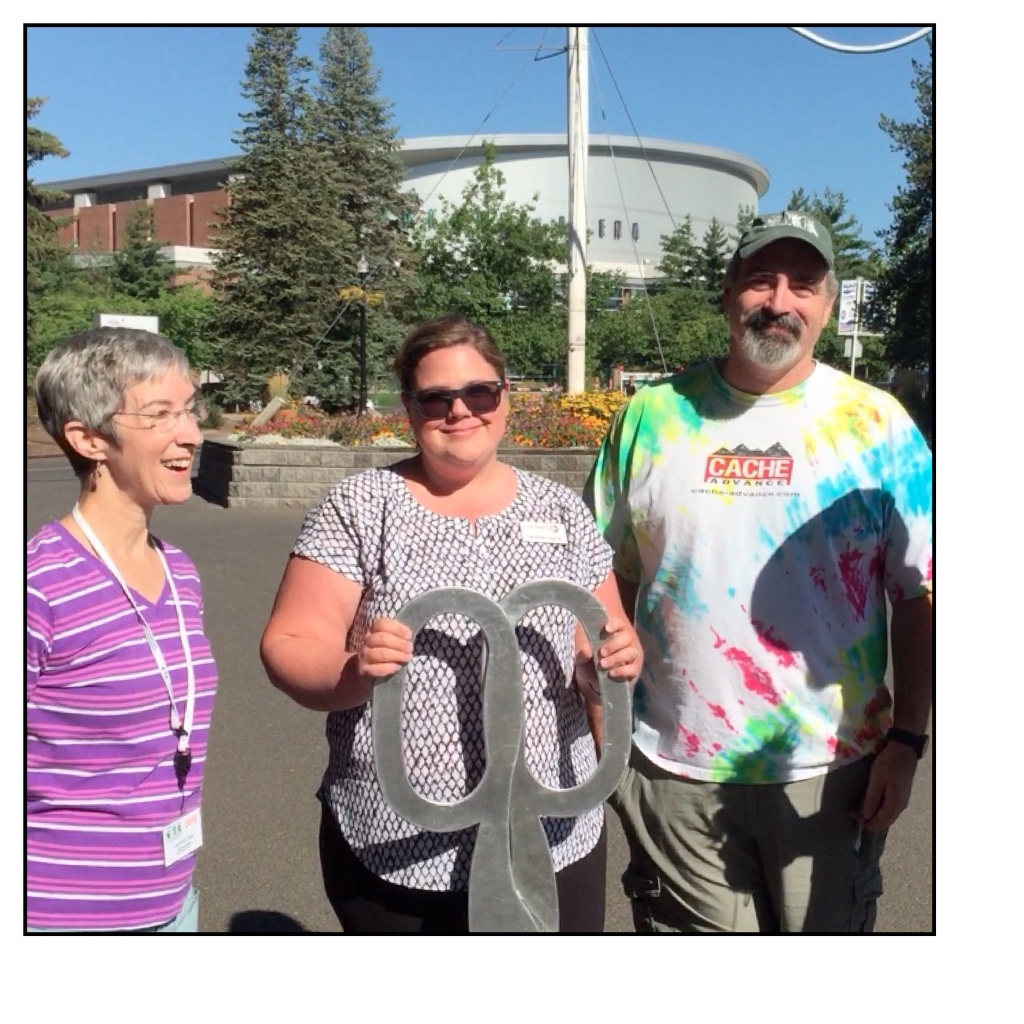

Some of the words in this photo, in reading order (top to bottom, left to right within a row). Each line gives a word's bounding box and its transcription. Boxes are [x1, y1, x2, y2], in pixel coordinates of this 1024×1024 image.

[708, 457, 791, 478] CACHE
[709, 478, 785, 486] ADVANCE
[691, 488, 801, 497] cache-advance.com
